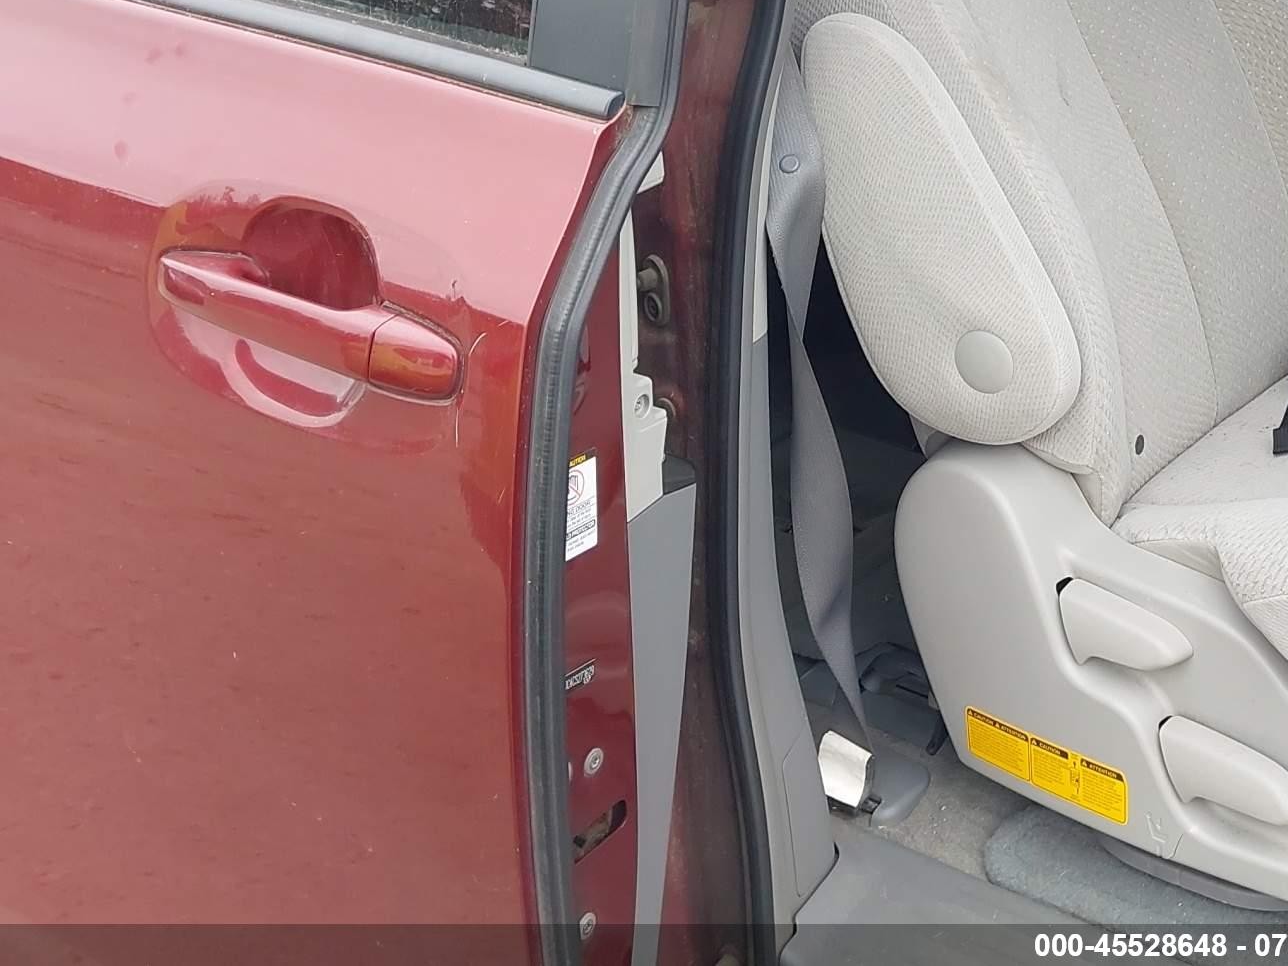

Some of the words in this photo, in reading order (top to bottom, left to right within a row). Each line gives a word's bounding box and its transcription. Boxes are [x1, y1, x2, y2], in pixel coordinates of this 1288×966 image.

[973, 712, 994, 727] CAUTION
[1000, 725, 1027, 740] ATTENTION
[1039, 742, 1061, 755] CAUTION
[1089, 762, 1117, 779] ATTENTION
